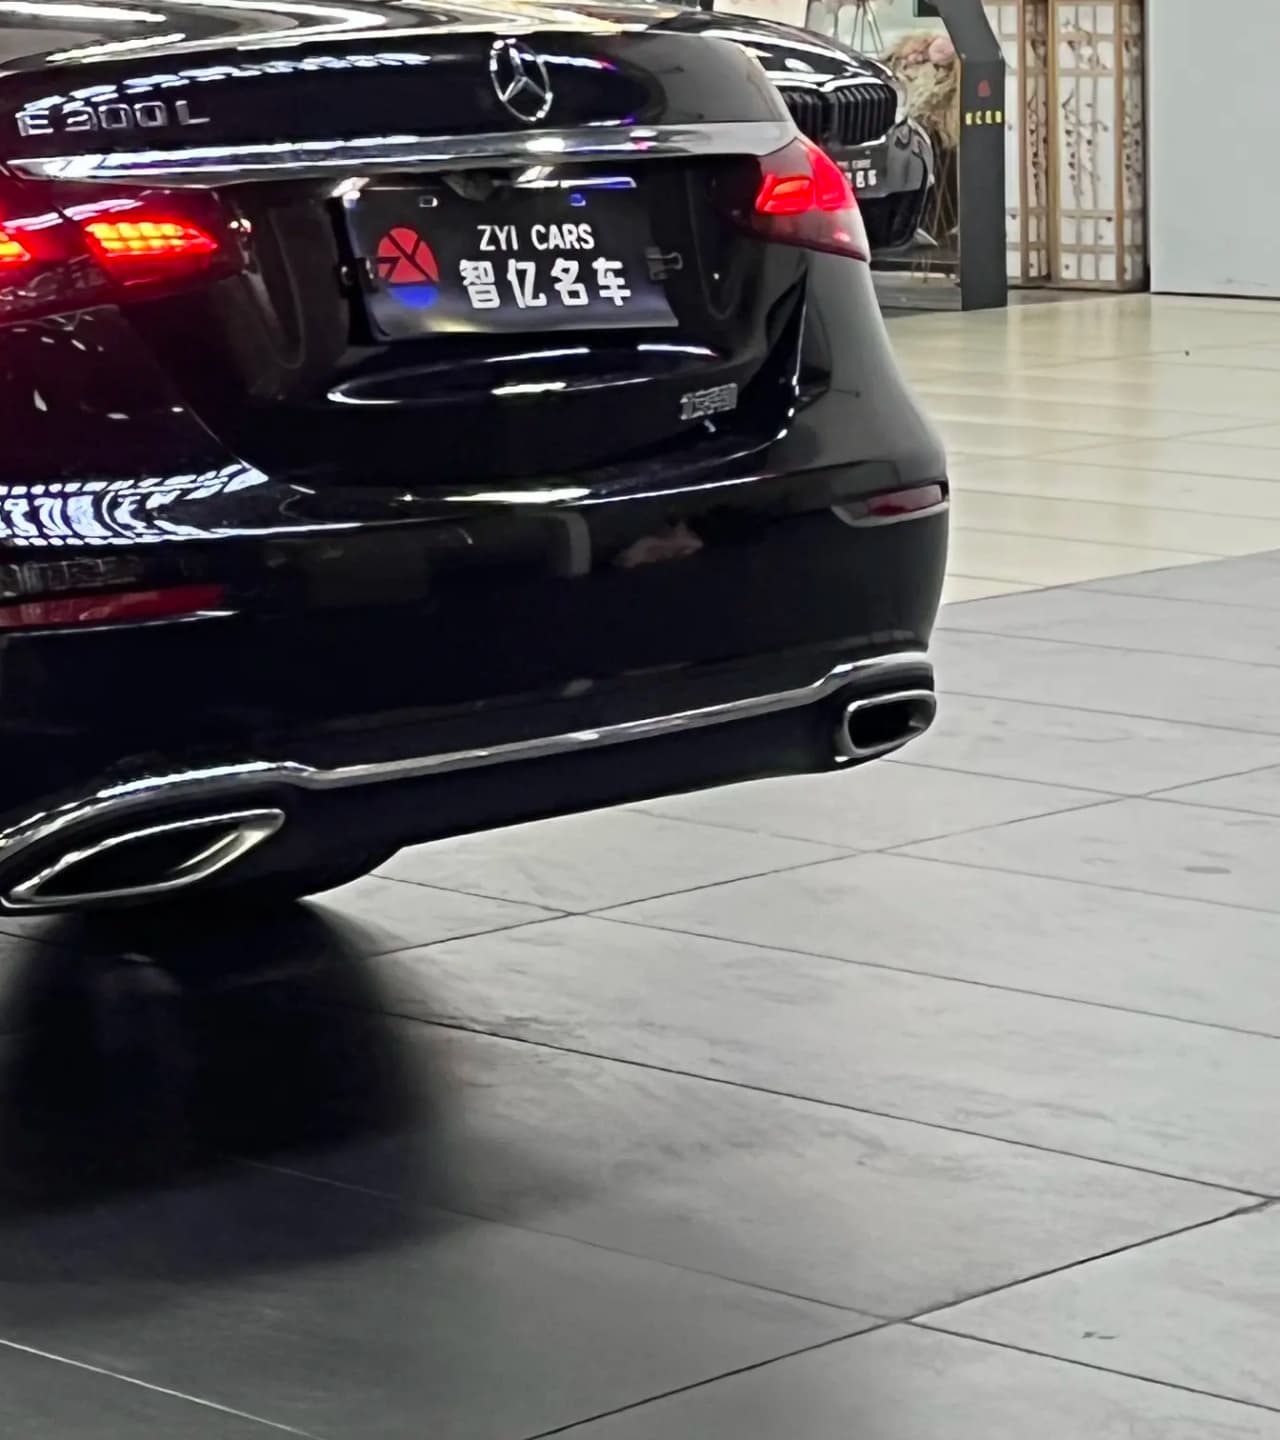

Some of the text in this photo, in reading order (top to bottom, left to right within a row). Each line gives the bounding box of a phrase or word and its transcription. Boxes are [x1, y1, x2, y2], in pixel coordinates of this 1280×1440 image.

[477, 222, 595, 251] ZYI CARS
[458, 257, 632, 309] 智亿名车
